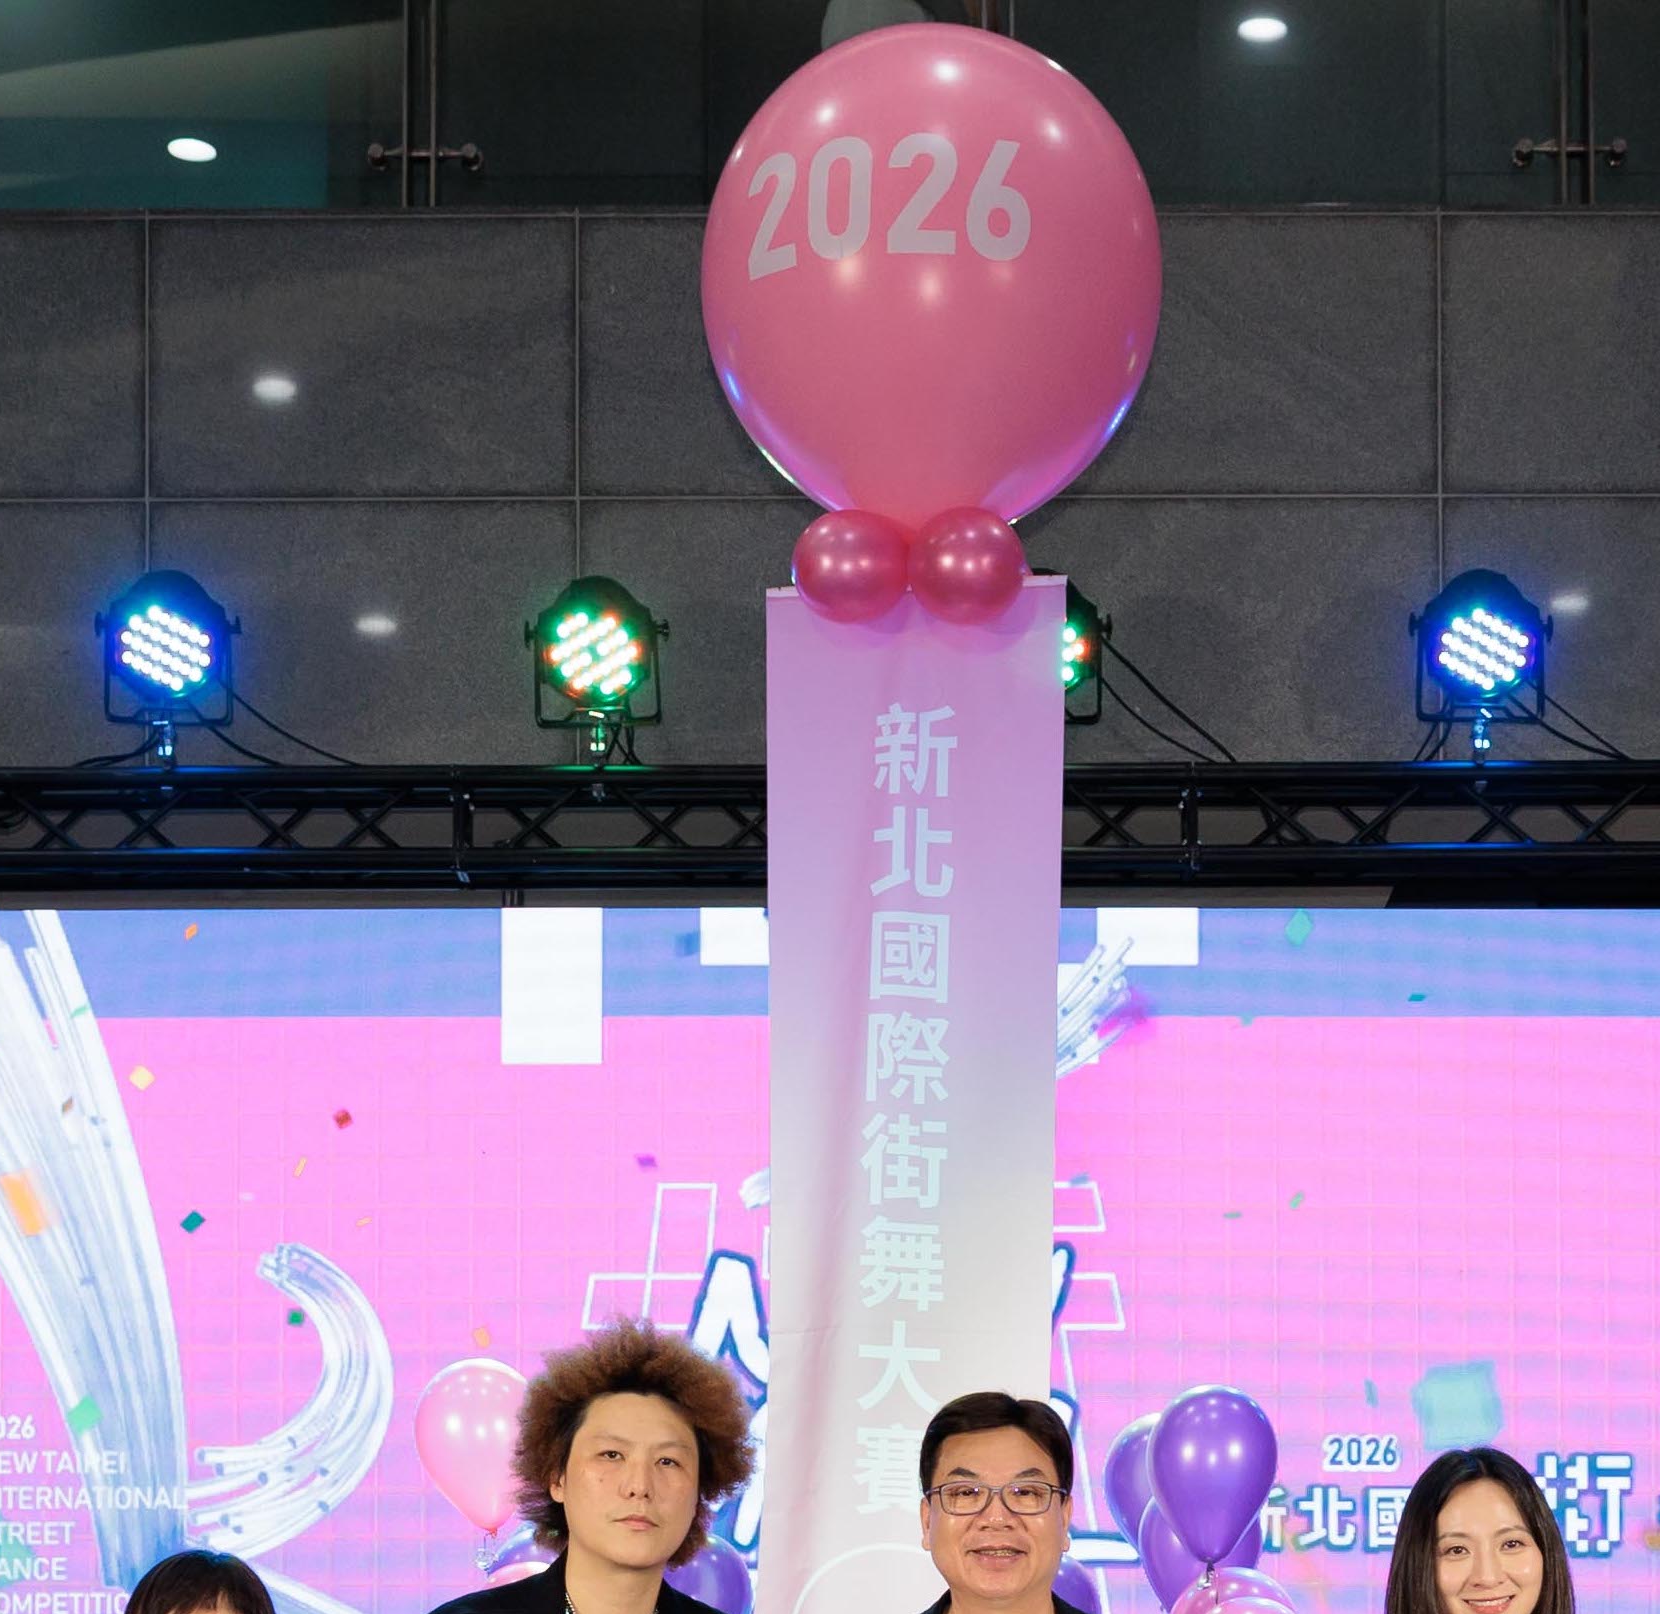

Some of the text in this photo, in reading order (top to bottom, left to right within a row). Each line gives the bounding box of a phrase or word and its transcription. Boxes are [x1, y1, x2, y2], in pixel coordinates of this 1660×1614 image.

[749, 133, 1031, 280] 2026
[855, 702, 957, 1518] 新北國際街舞大賽
[42, 1452, 127, 1474] TAIPEI
[1328, 1437, 1398, 1467] 2026
